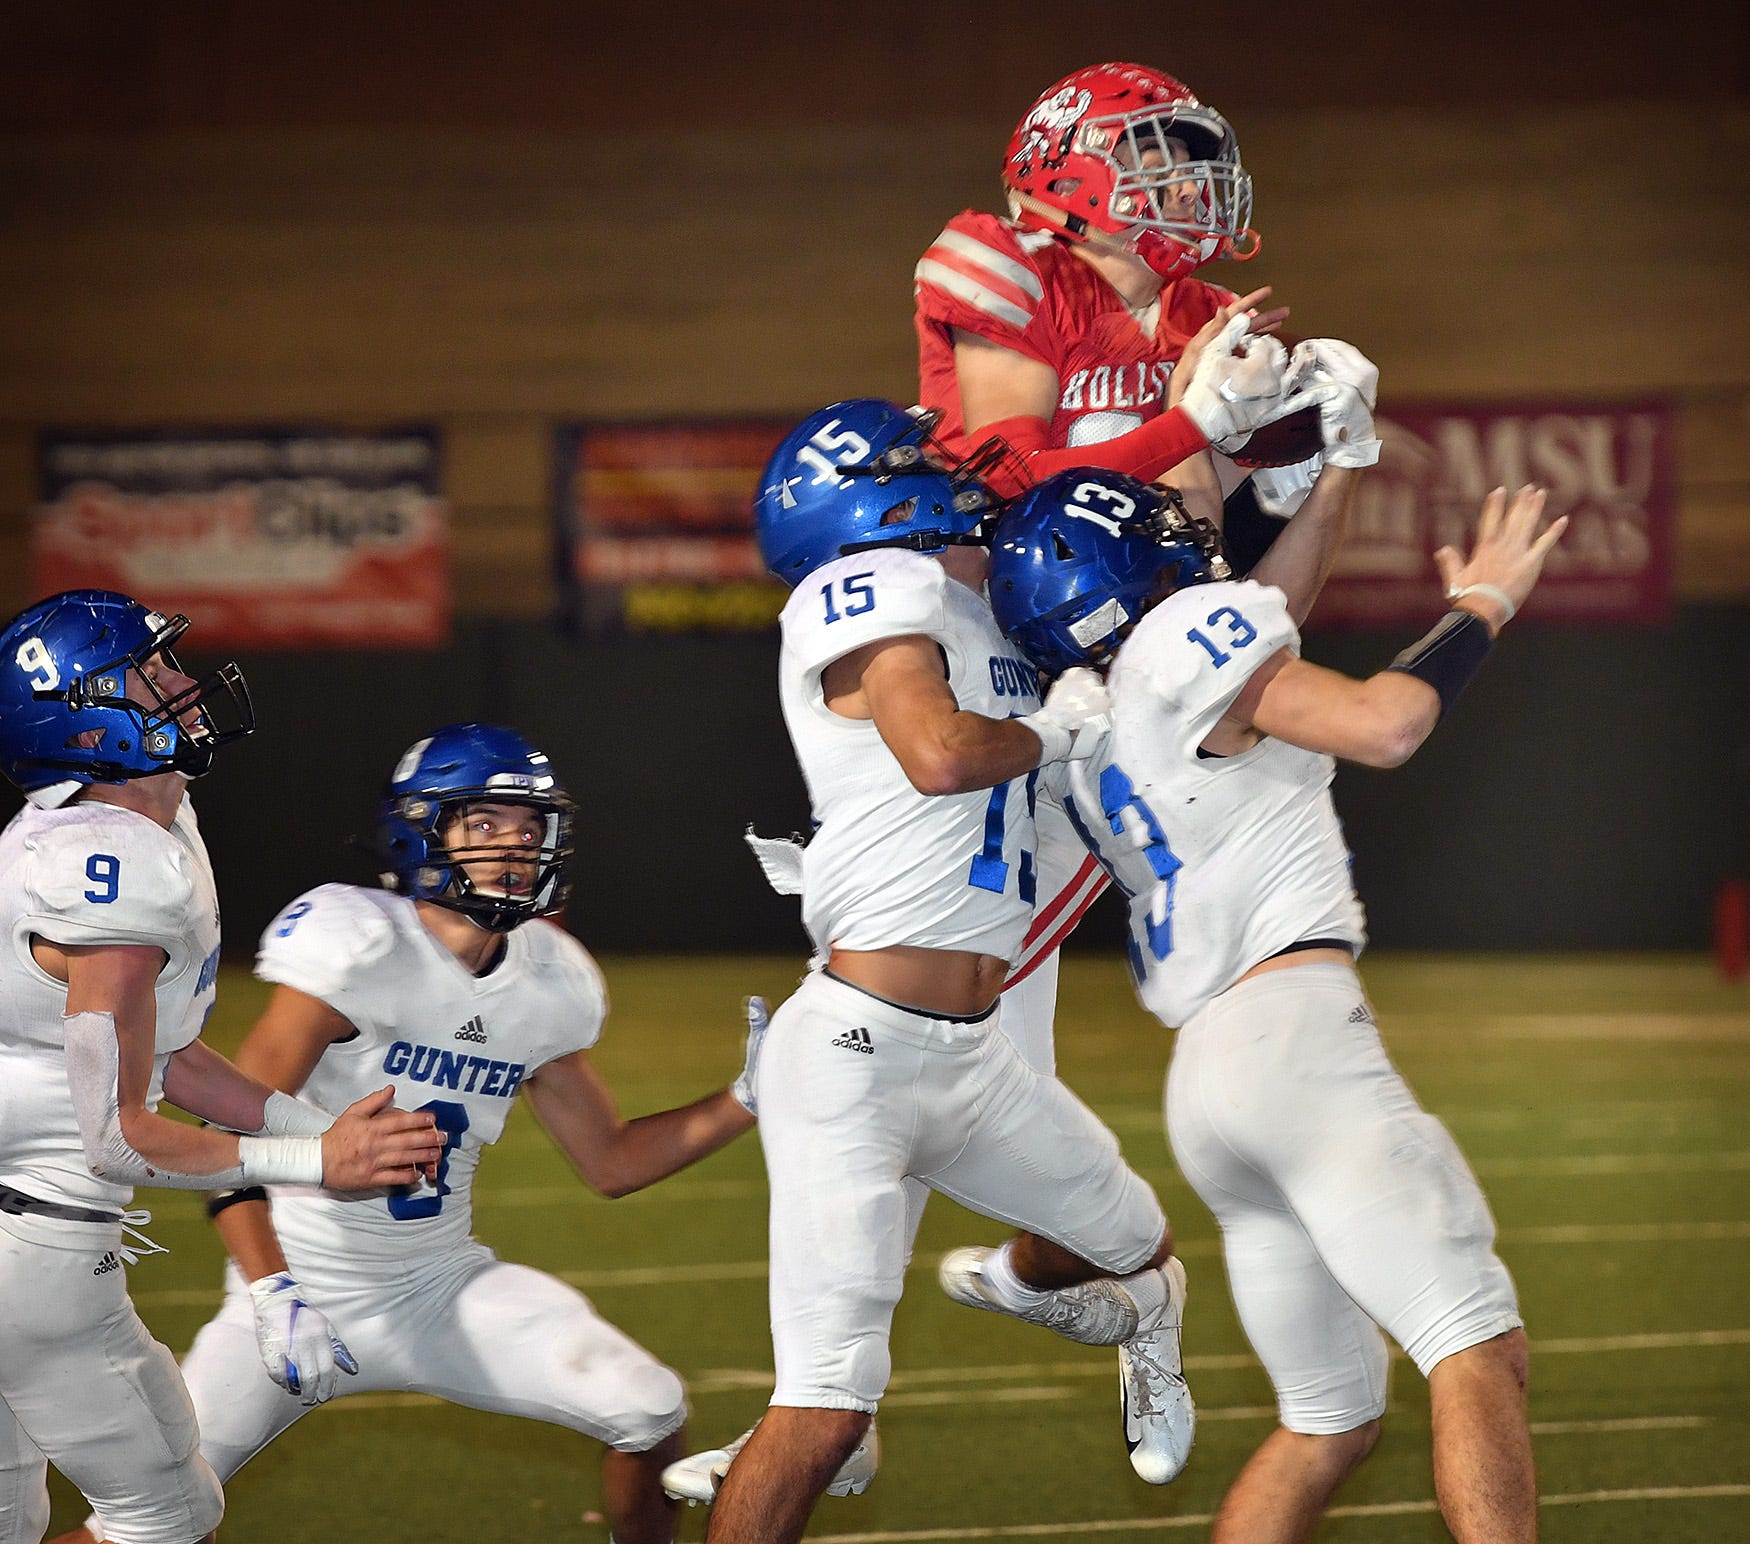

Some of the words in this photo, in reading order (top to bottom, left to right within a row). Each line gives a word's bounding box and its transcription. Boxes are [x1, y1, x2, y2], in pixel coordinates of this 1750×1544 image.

[796, 418, 871, 486] 15
[1063, 482, 1137, 538] 13
[821, 570, 876, 625] 15
[15, 637, 61, 692] 9
[1186, 607, 1258, 669] 13
[988, 656, 1040, 698] GUN
[84, 853, 120, 904] 9
[383, 1040, 527, 1099] GUNTER
[831, 1038, 875, 1055] adidas
